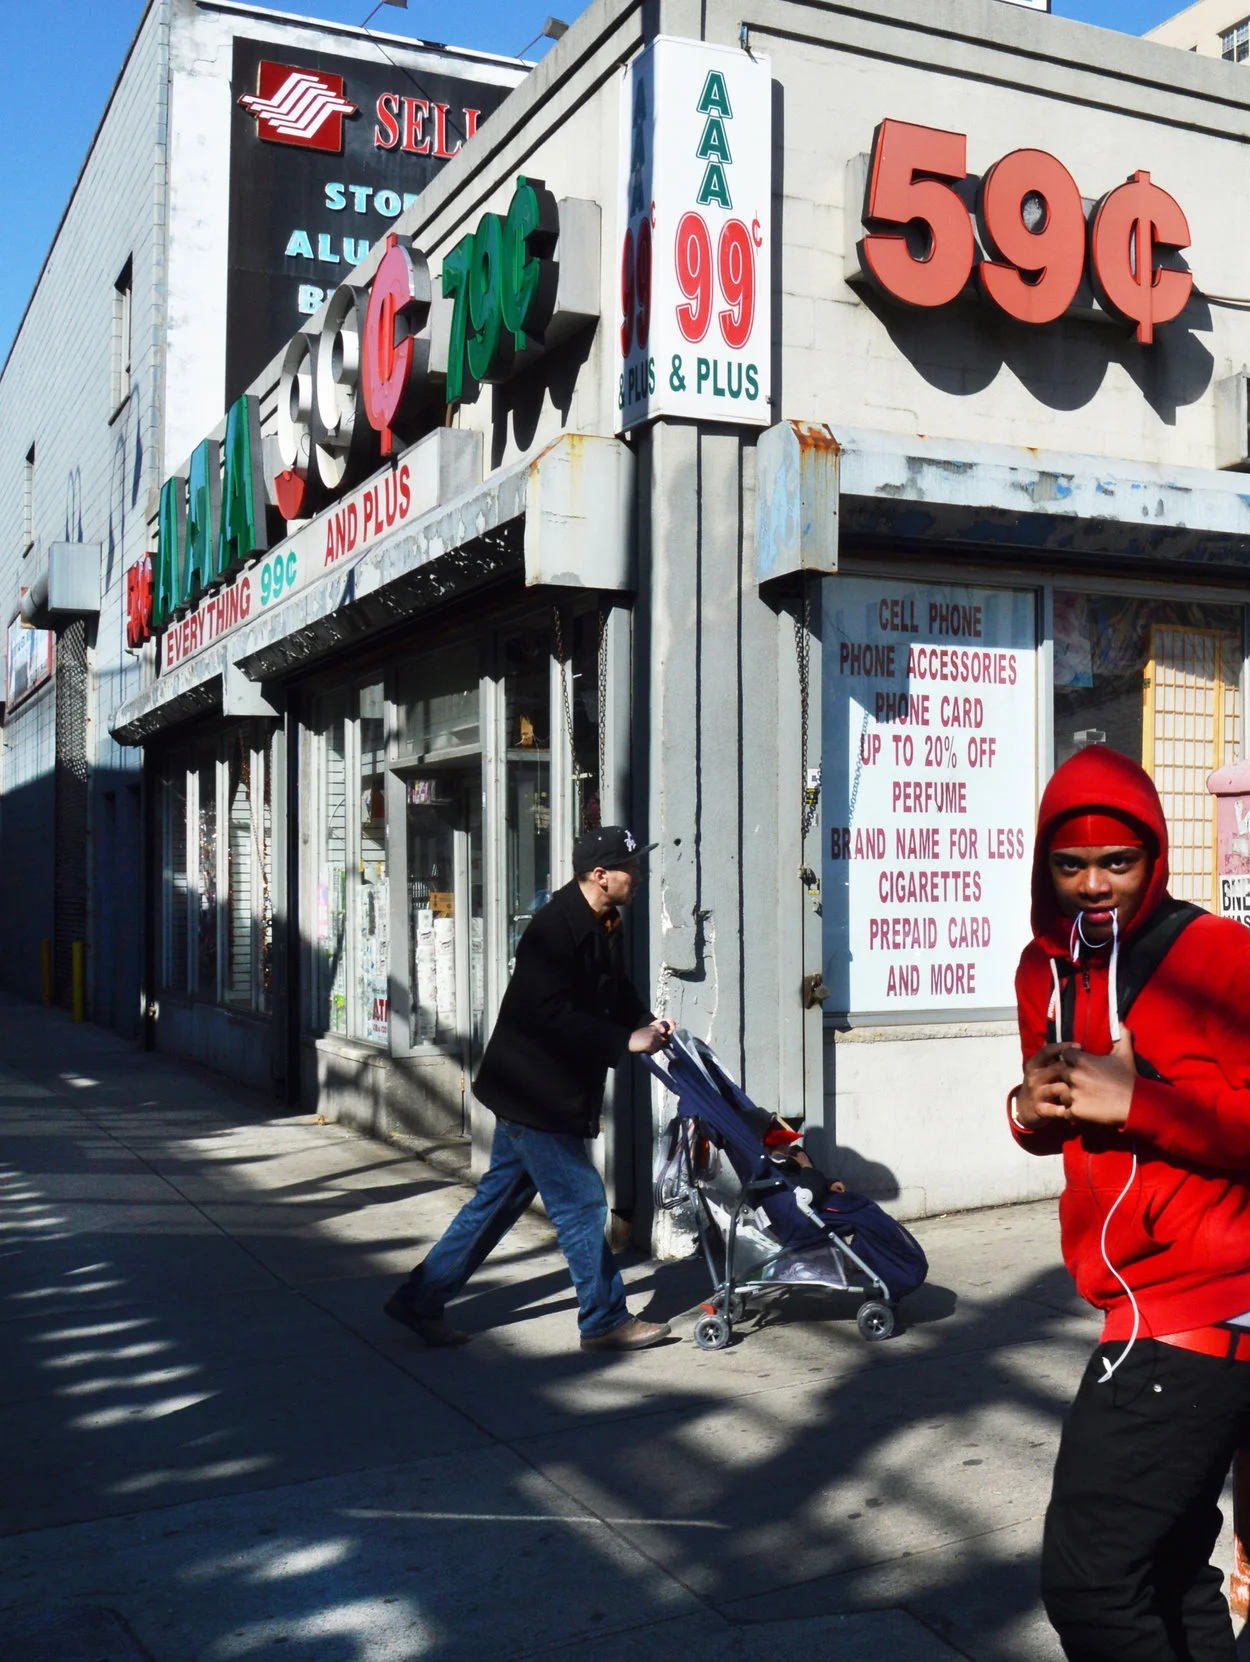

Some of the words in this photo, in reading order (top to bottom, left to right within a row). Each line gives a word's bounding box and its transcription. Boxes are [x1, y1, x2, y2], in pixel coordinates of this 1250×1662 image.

[695, 69, 733, 210] AAA
[862, 118, 1193, 344] 59¢
[628, 356, 656, 407] PLUS
[669, 353, 687, 392] &
[696, 357, 759, 401] PLUS
[324, 502, 358, 567] AND
[362, 464, 411, 543] PLUS
[260, 548, 297, 606] 99¢
[166, 576, 250, 668] EVERYTHING
[878, 598, 918, 633] CELL
[929, 602, 982, 637] PHONE
[840, 642, 895, 678] PHONE
[906, 647, 1017, 685] ACCESSORIES
[875, 691, 930, 726] PHONE
[940, 696, 984, 728] CARD
[861, 733, 881, 766] UP
[892, 734, 913, 766] TO
[924, 735, 957, 768] 20%
[967, 736, 996, 768] OFF
[892, 781, 967, 813] PERFUME
[830, 827, 886, 860] BRAND
[895, 828, 939, 860] NAME
[949, 828, 978, 859] FOR
[988, 828, 1025, 859] LESS
[878, 871, 981, 903] CIGARETTES
[869, 917, 937, 950] PREPAID
[949, 916, 991, 948] CARD
[886, 964, 920, 996] AND
[930, 963, 975, 995] MORE
